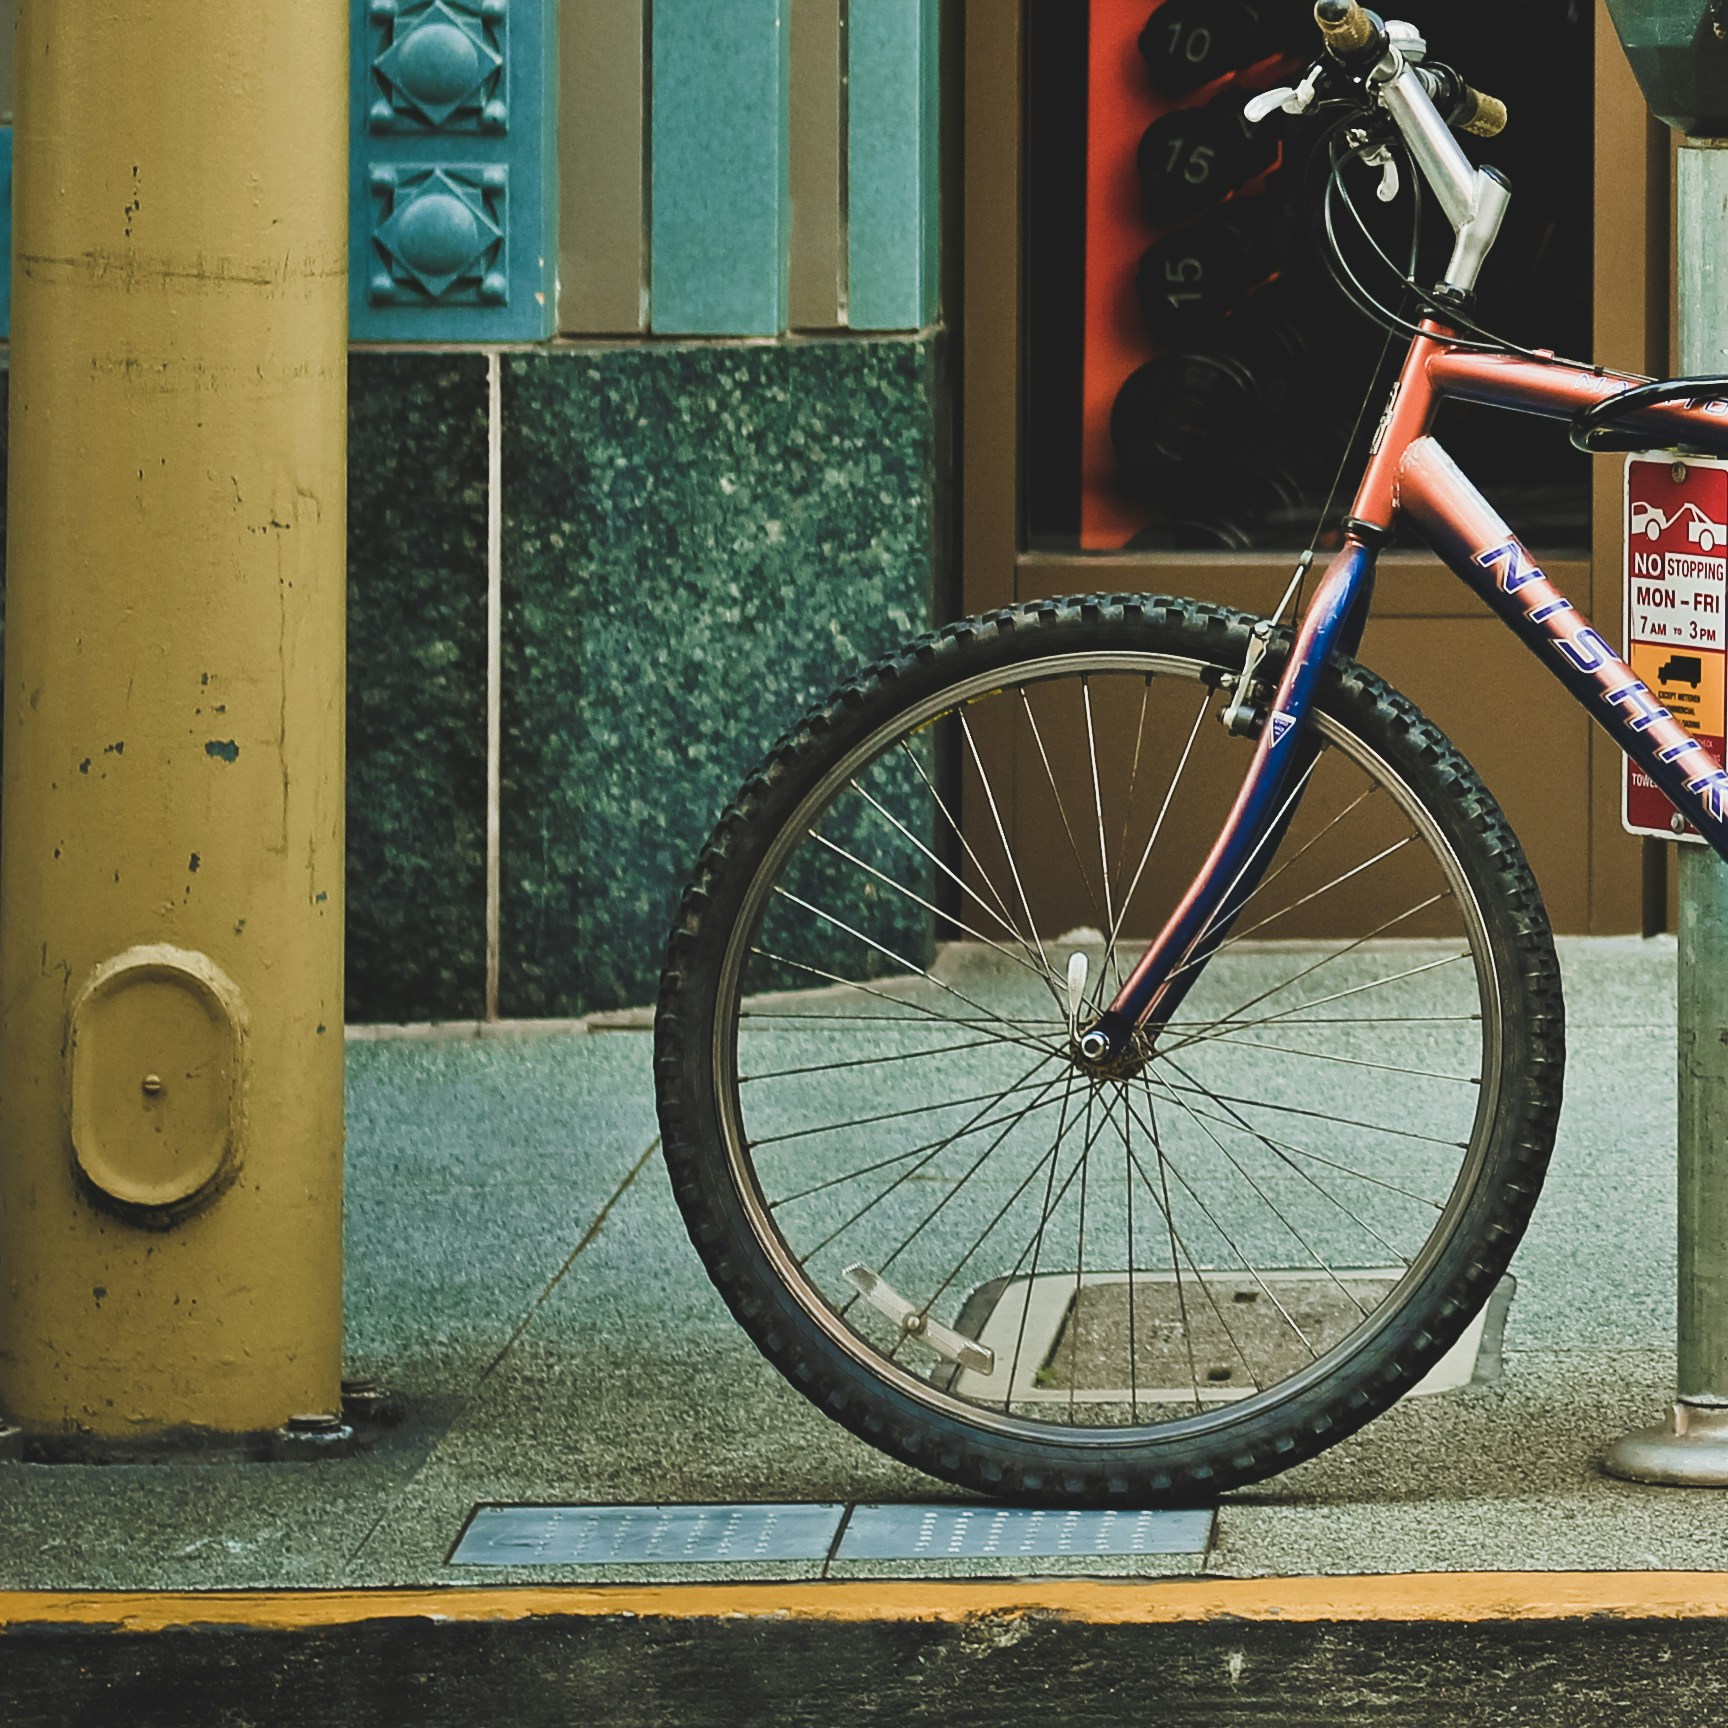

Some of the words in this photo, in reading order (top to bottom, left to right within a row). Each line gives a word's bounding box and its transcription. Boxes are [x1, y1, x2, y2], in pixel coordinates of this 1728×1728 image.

[1168, 22, 1211, 63] 10
[1166, 138, 1215, 184] 15
[1165, 257, 1203, 309] 15
[1634, 552, 1662, 576] NO
[1667, 558, 1724, 581] STOPPING
[1637, 586, 1676, 608] MON
[1694, 592, 1720, 613] FRI
